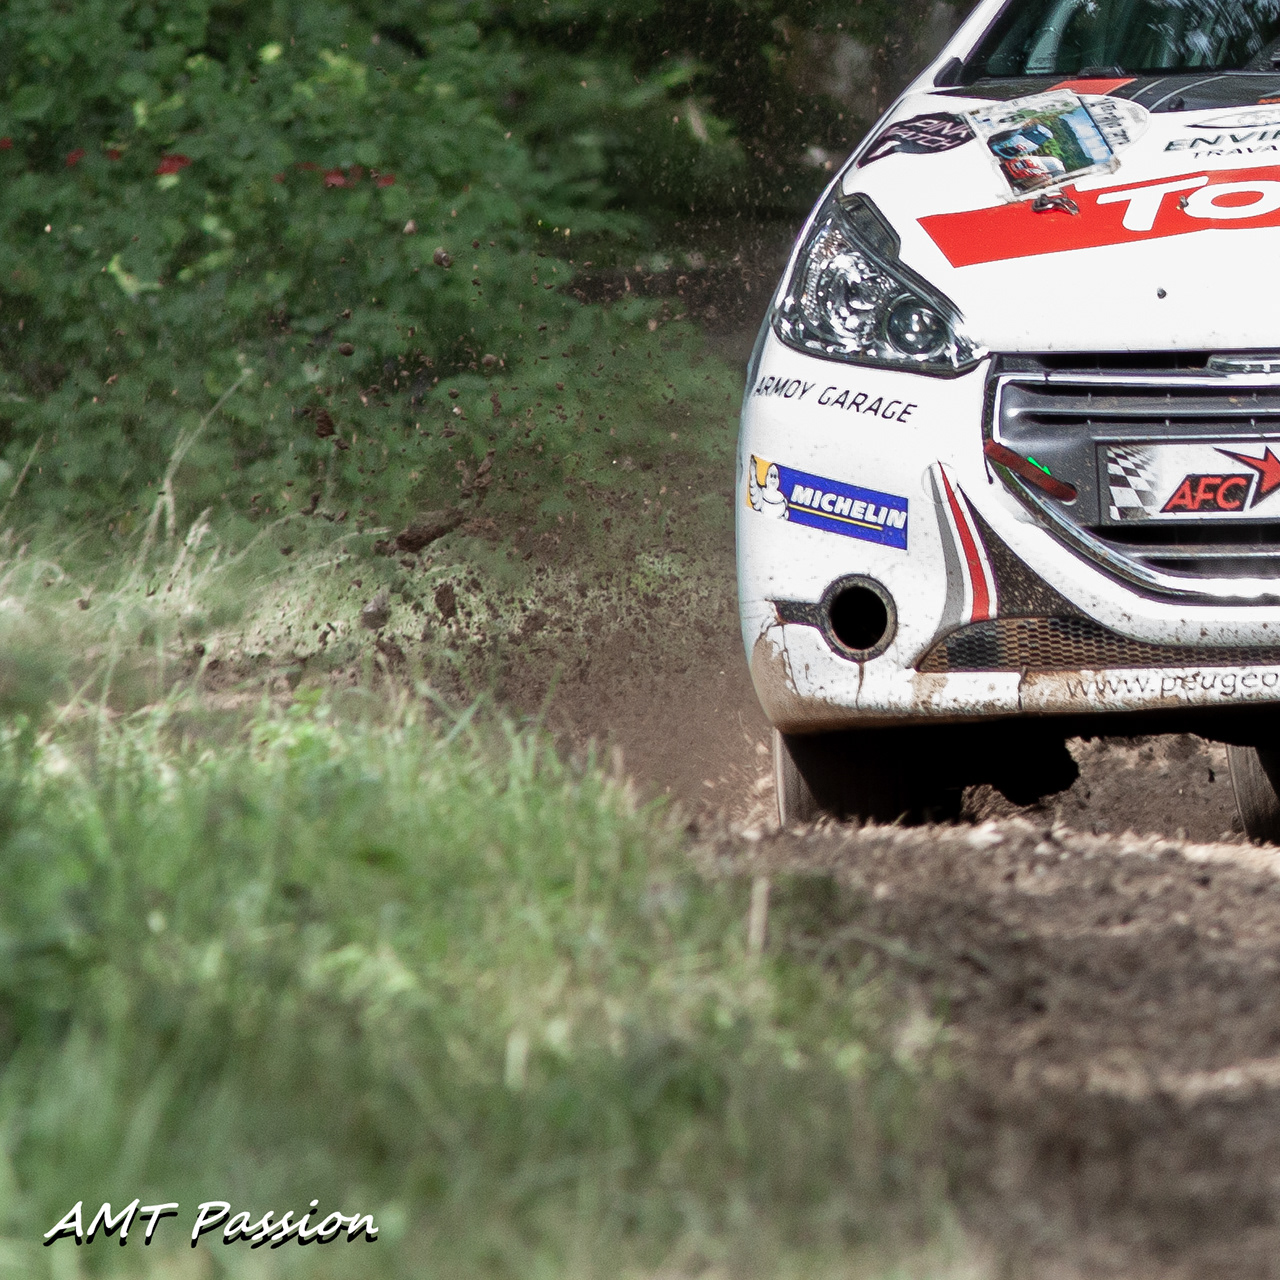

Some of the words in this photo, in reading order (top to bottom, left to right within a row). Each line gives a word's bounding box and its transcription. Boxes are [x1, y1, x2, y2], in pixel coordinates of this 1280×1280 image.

[754, 375, 816, 401] ARMOY
[818, 386, 918, 423] GARAGE
[790, 483, 909, 530] MICHELIN
[1164, 476, 1246, 512] AFC
